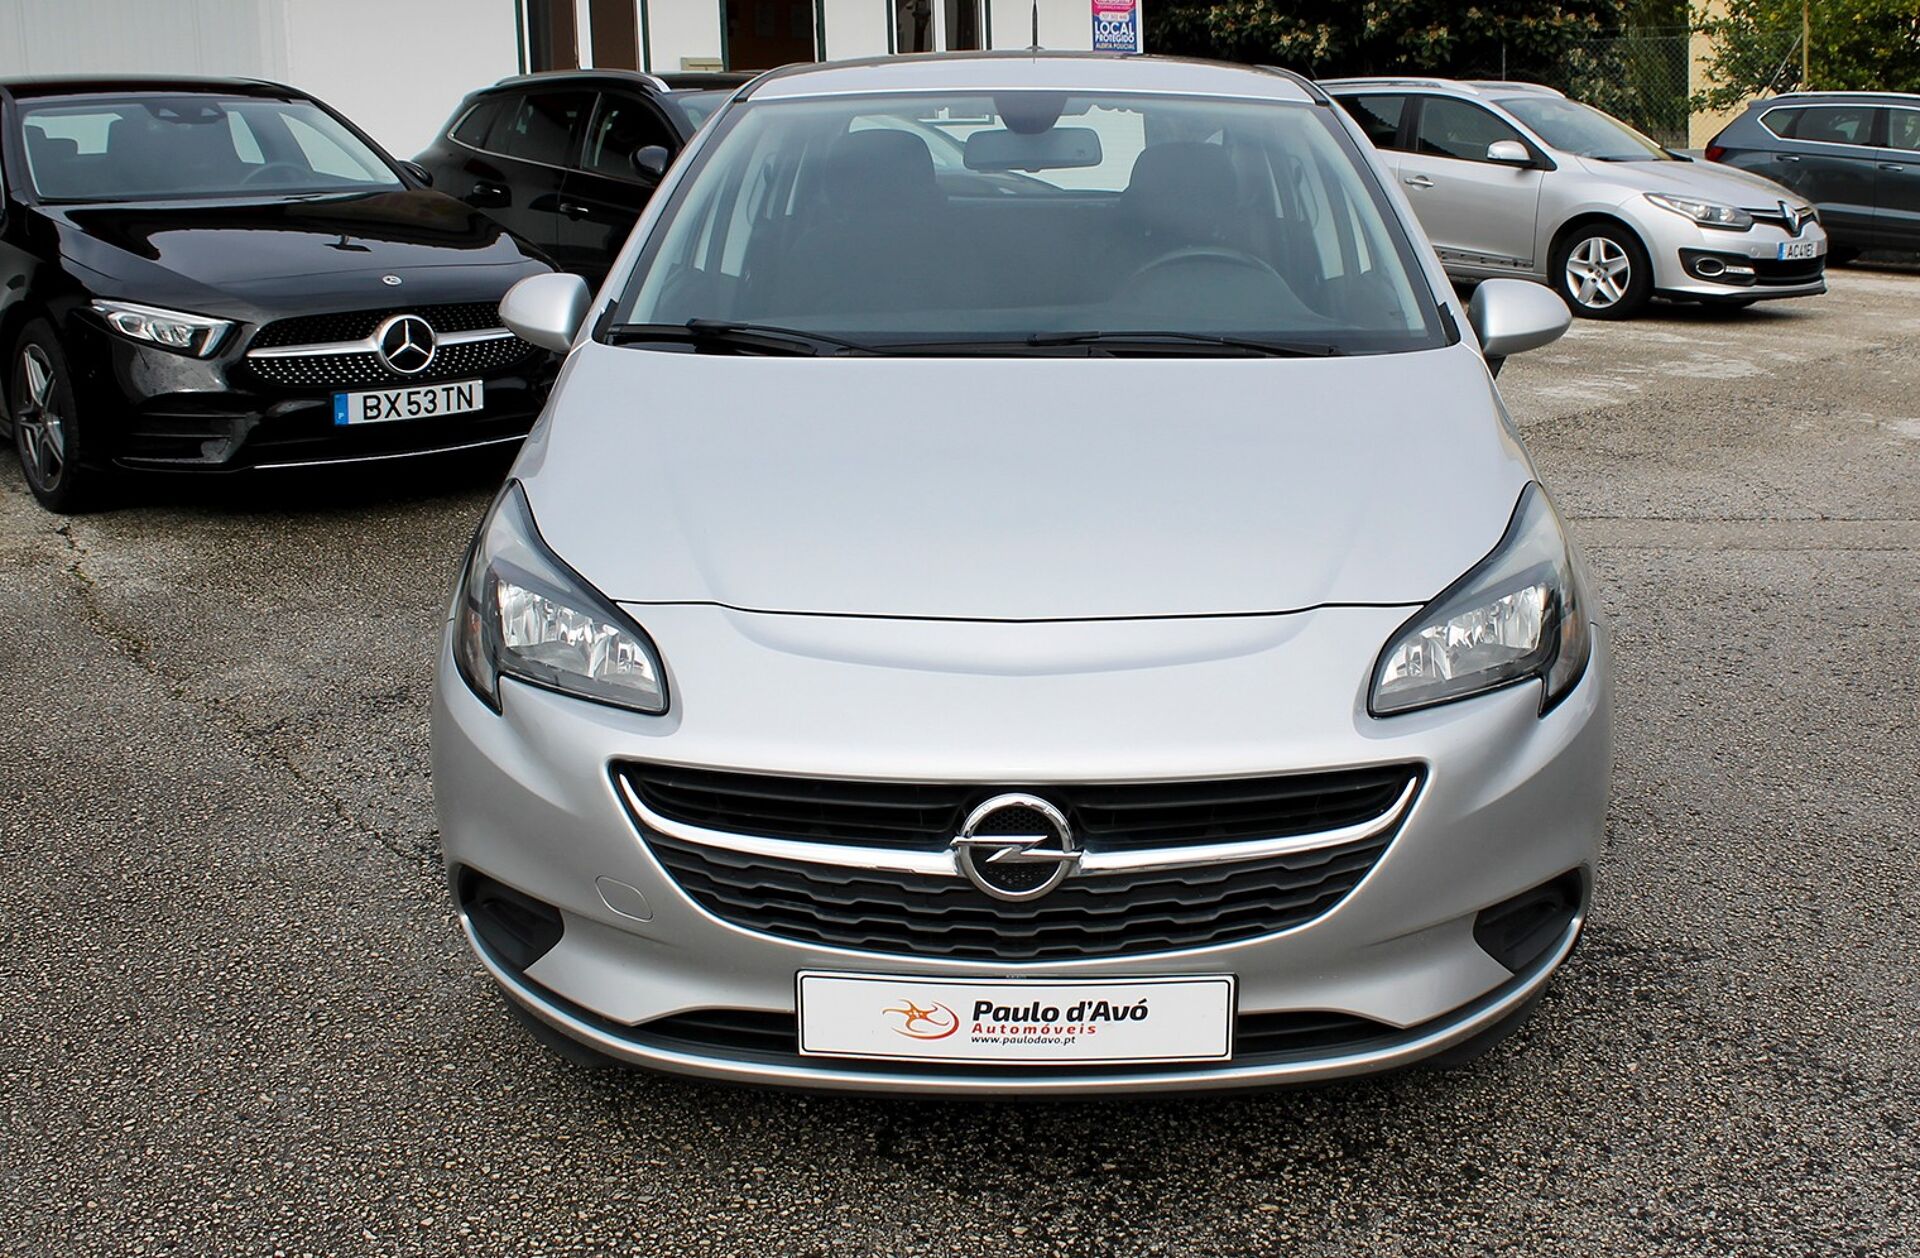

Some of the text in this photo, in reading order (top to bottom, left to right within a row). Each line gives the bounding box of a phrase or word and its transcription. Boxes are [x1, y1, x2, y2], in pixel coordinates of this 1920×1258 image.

[1094, 21, 1134, 34] LOCAL
[1095, 34, 1135, 43] PROTEGIDO
[972, 998, 1149, 1023] Paulo d'Avó
[971, 1022, 1097, 1034] Automóveis
[970, 1035, 1076, 1046] www.paulodavo.pt
